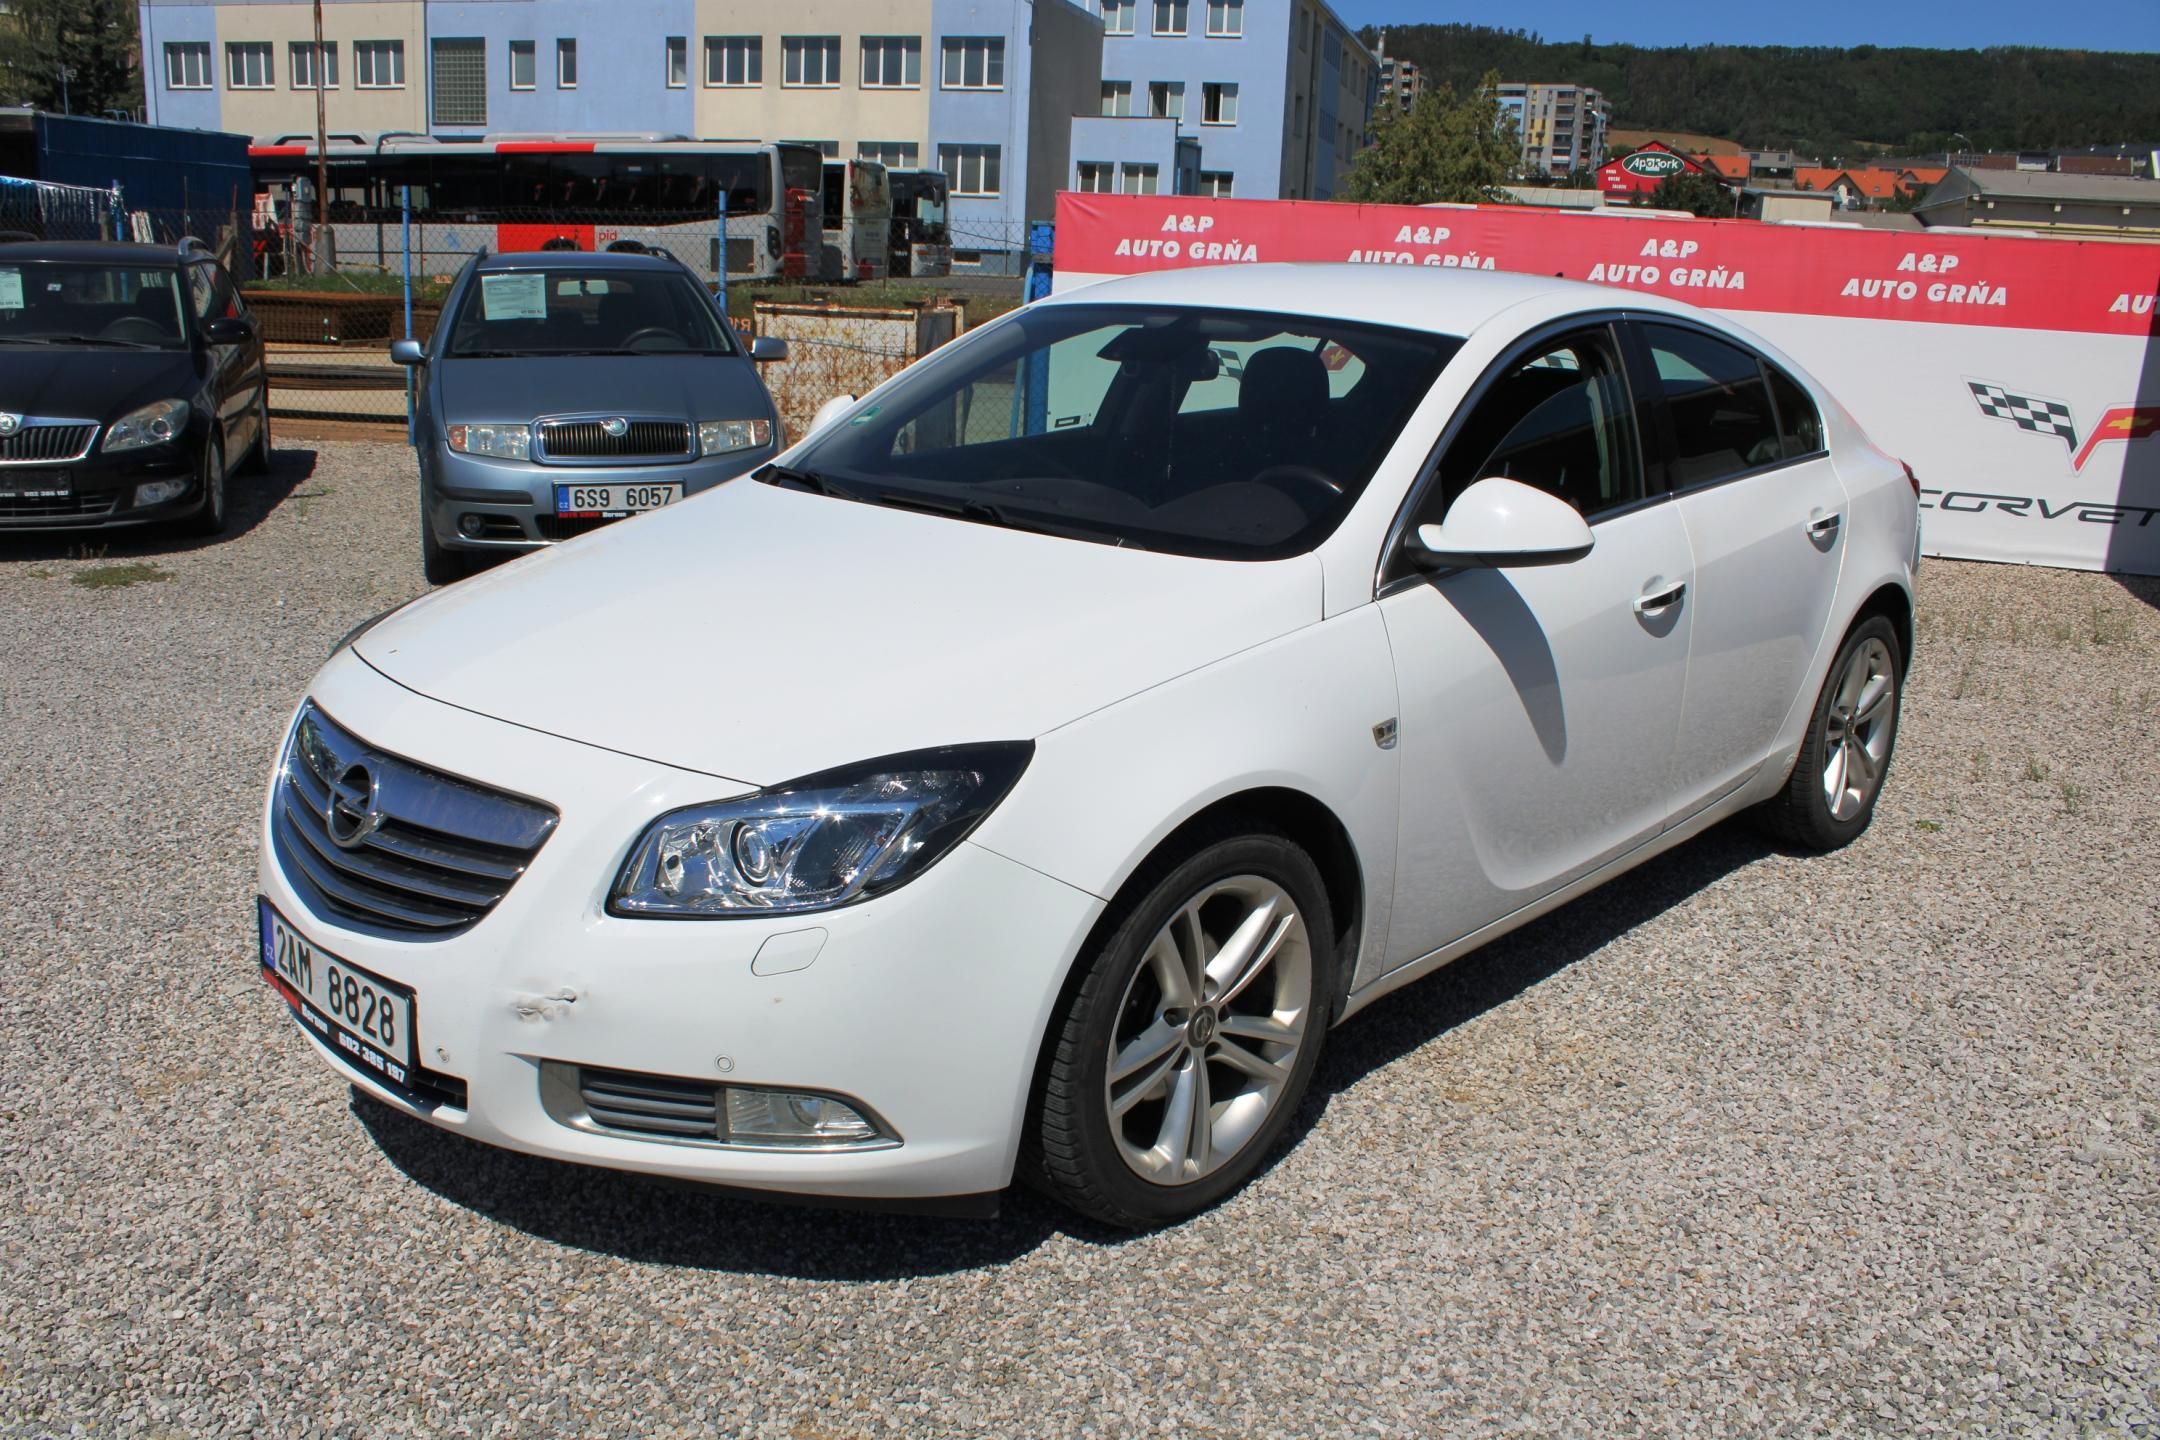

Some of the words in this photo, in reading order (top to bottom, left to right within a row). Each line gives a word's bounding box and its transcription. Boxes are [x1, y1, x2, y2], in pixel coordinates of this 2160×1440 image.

[1161, 214, 1214, 232] A&P
[599, 229, 617, 242] pid
[1394, 225, 1451, 245] A&P
[1114, 239, 1181, 258] AUTO
[1188, 239, 1258, 262] GRŇA
[1640, 238, 1699, 258] A&P
[1896, 252, 1959, 273] A&P
[1586, 263, 1660, 285] AUTO
[1669, 266, 1745, 290] GRŇA
[1840, 278, 1917, 300] AUTO
[1926, 281, 2007, 306] GRŇA
[574, 489, 610, 508] 6S9
[626, 487, 673, 507] 6057
[265, 943, 275, 960] CZ
[277, 924, 313, 995] 2AM
[328, 965, 394, 1047] 8828
[338, 1030, 360, 1055] 602
[362, 1046, 384, 1069] 385
[386, 1061, 406, 1084] 197
